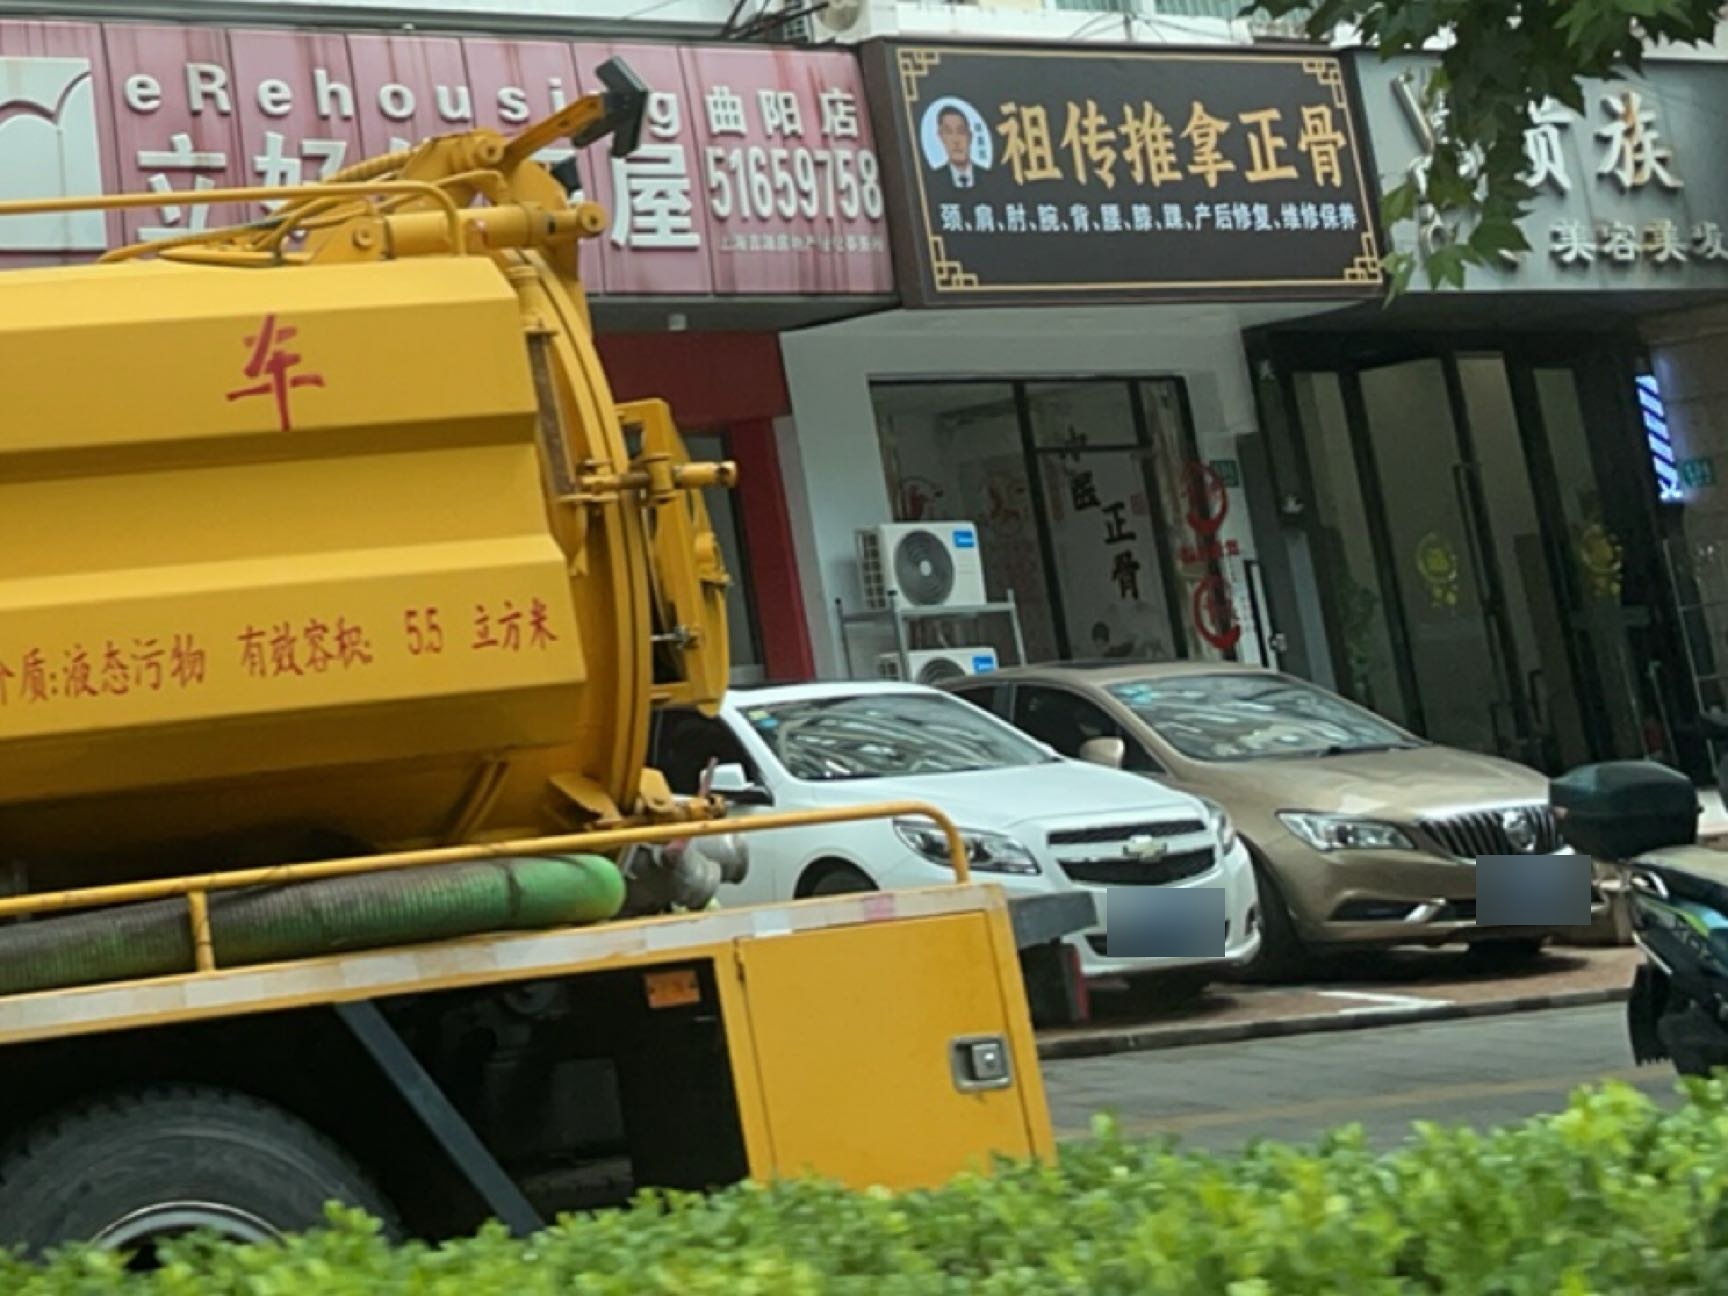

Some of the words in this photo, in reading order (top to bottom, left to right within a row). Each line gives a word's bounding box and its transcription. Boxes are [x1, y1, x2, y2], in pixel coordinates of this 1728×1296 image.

[124, 59, 680, 138] eRehousig
[706, 85, 860, 139] 曲阳店
[997, 99, 1348, 191] 祖传推拿正骨
[707, 147, 884, 222] 51659758
[471, 597, 558, 651] 立方米
